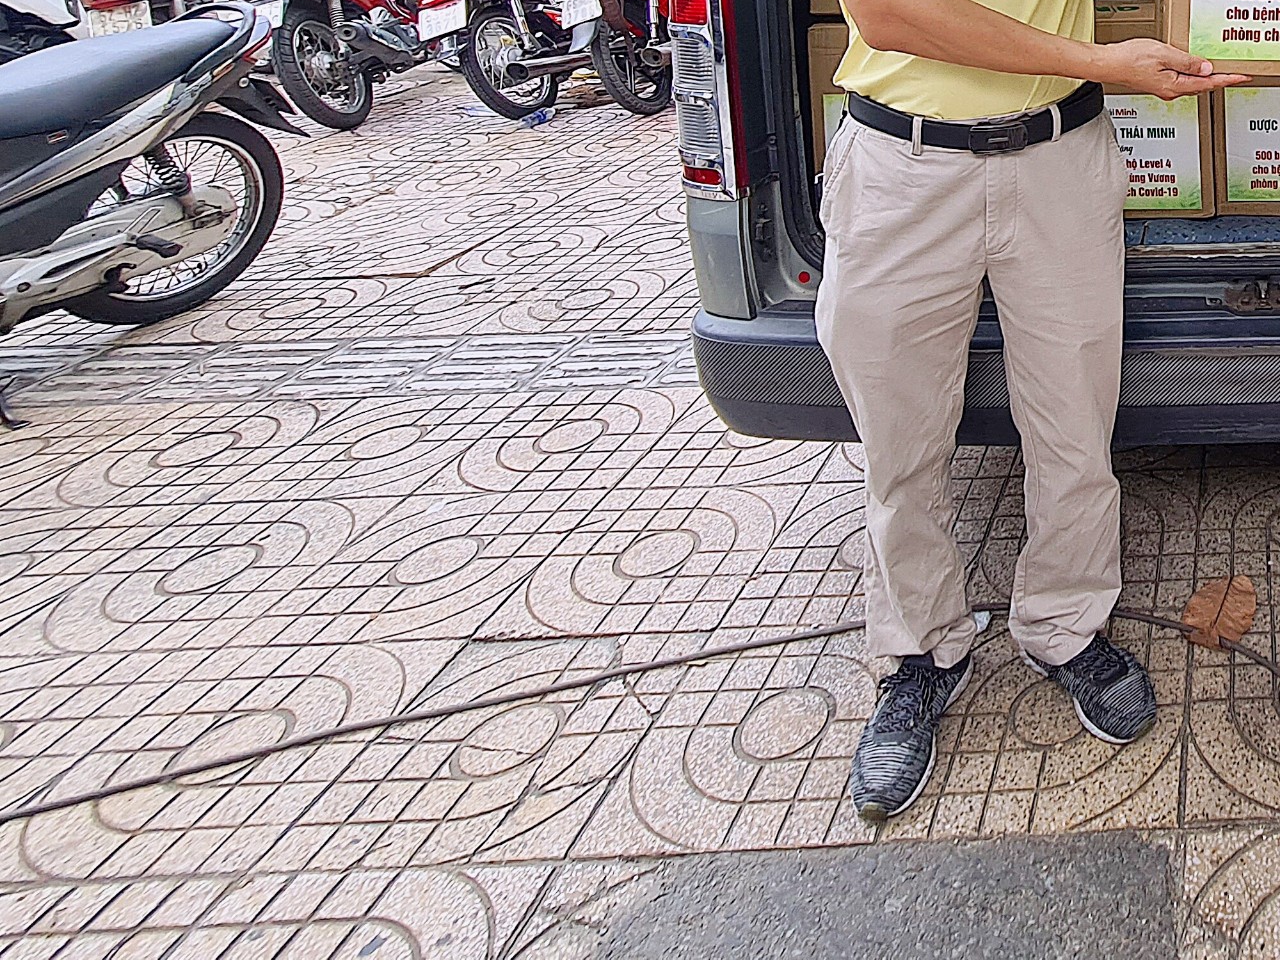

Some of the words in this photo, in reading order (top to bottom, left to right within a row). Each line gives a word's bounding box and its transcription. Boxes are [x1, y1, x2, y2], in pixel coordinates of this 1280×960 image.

[1226, 7, 1250, 21] cho
[1222, 27, 1261, 43] phòng
[1119, 125, 1144, 138] THÁI
[1146, 127, 1175, 139] MINH
[1249, 119, 1278, 133] DƯỢC
[1255, 150, 1273, 160] 500
[1126, 158, 1138, 171] hộ
[1139, 158, 1164, 169] Level
[1165, 159, 1172, 169] 4
[1252, 164, 1269, 175] cho
[1129, 173, 1146, 184] ùng
[1147, 173, 1176, 184] Vương
[1250, 178, 1278, 190] phòng
[1138, 187, 1178, 197] Covid-19
